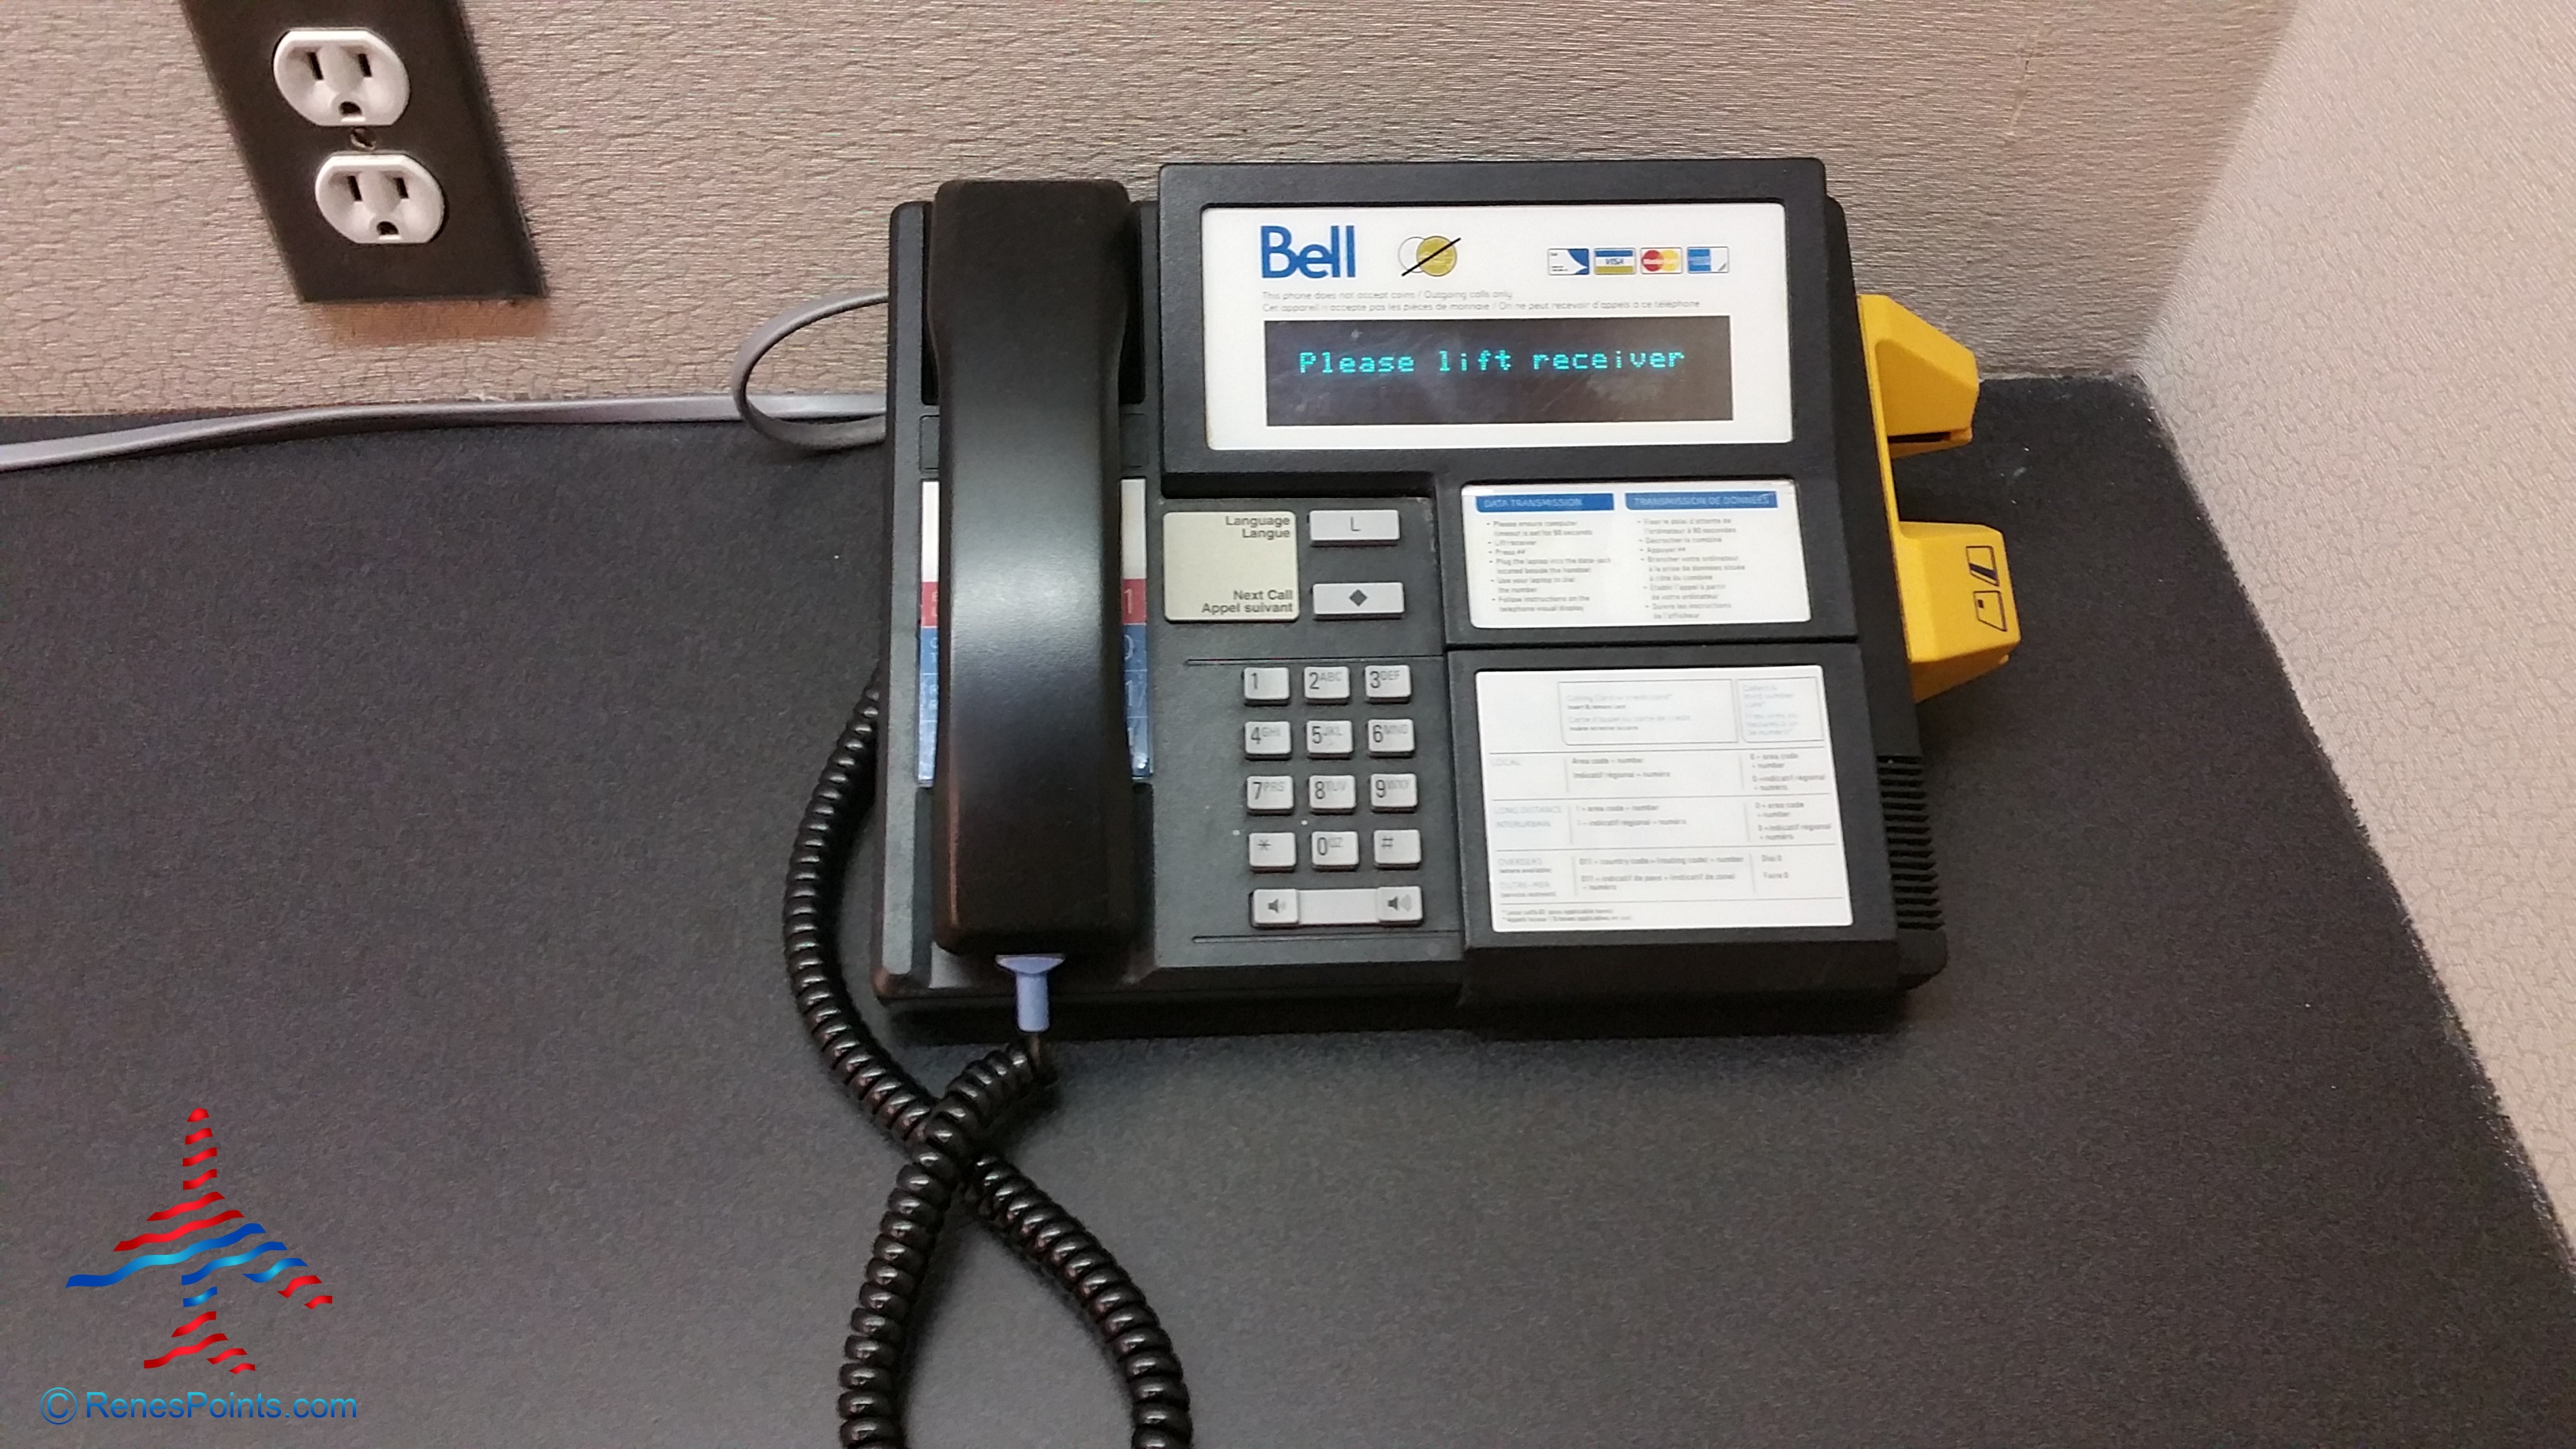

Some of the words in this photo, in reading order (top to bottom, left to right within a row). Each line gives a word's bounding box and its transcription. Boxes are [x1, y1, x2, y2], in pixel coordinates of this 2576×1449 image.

[1261, 225, 1356, 279] Bell
[1299, 351, 1415, 374] Please
[1439, 350, 1512, 373] lift
[1533, 347, 1685, 371] receiver
[1226, 515, 1290, 527] Language
[1350, 517, 1360, 531] L
[1241, 529, 1290, 540] Langue
[1234, 590, 1264, 600] Next
[1267, 590, 1293, 600] Call
[1201, 603, 1240, 614] Appel
[1245, 603, 1293, 612] suivant
[1251, 672, 1258, 690] 1
[1309, 672, 1320, 690] 2
[1320, 672, 1342, 681] ABC
[1369, 671, 1380, 688] 3
[1250, 727, 1261, 744] 4
[1312, 726, 1322, 743] 5
[1372, 725, 1383, 743] 6
[1252, 781, 1263, 799] 7
[1315, 781, 1325, 799] 8
[1376, 780, 1386, 798] 9
[1317, 837, 1327, 856] 0
